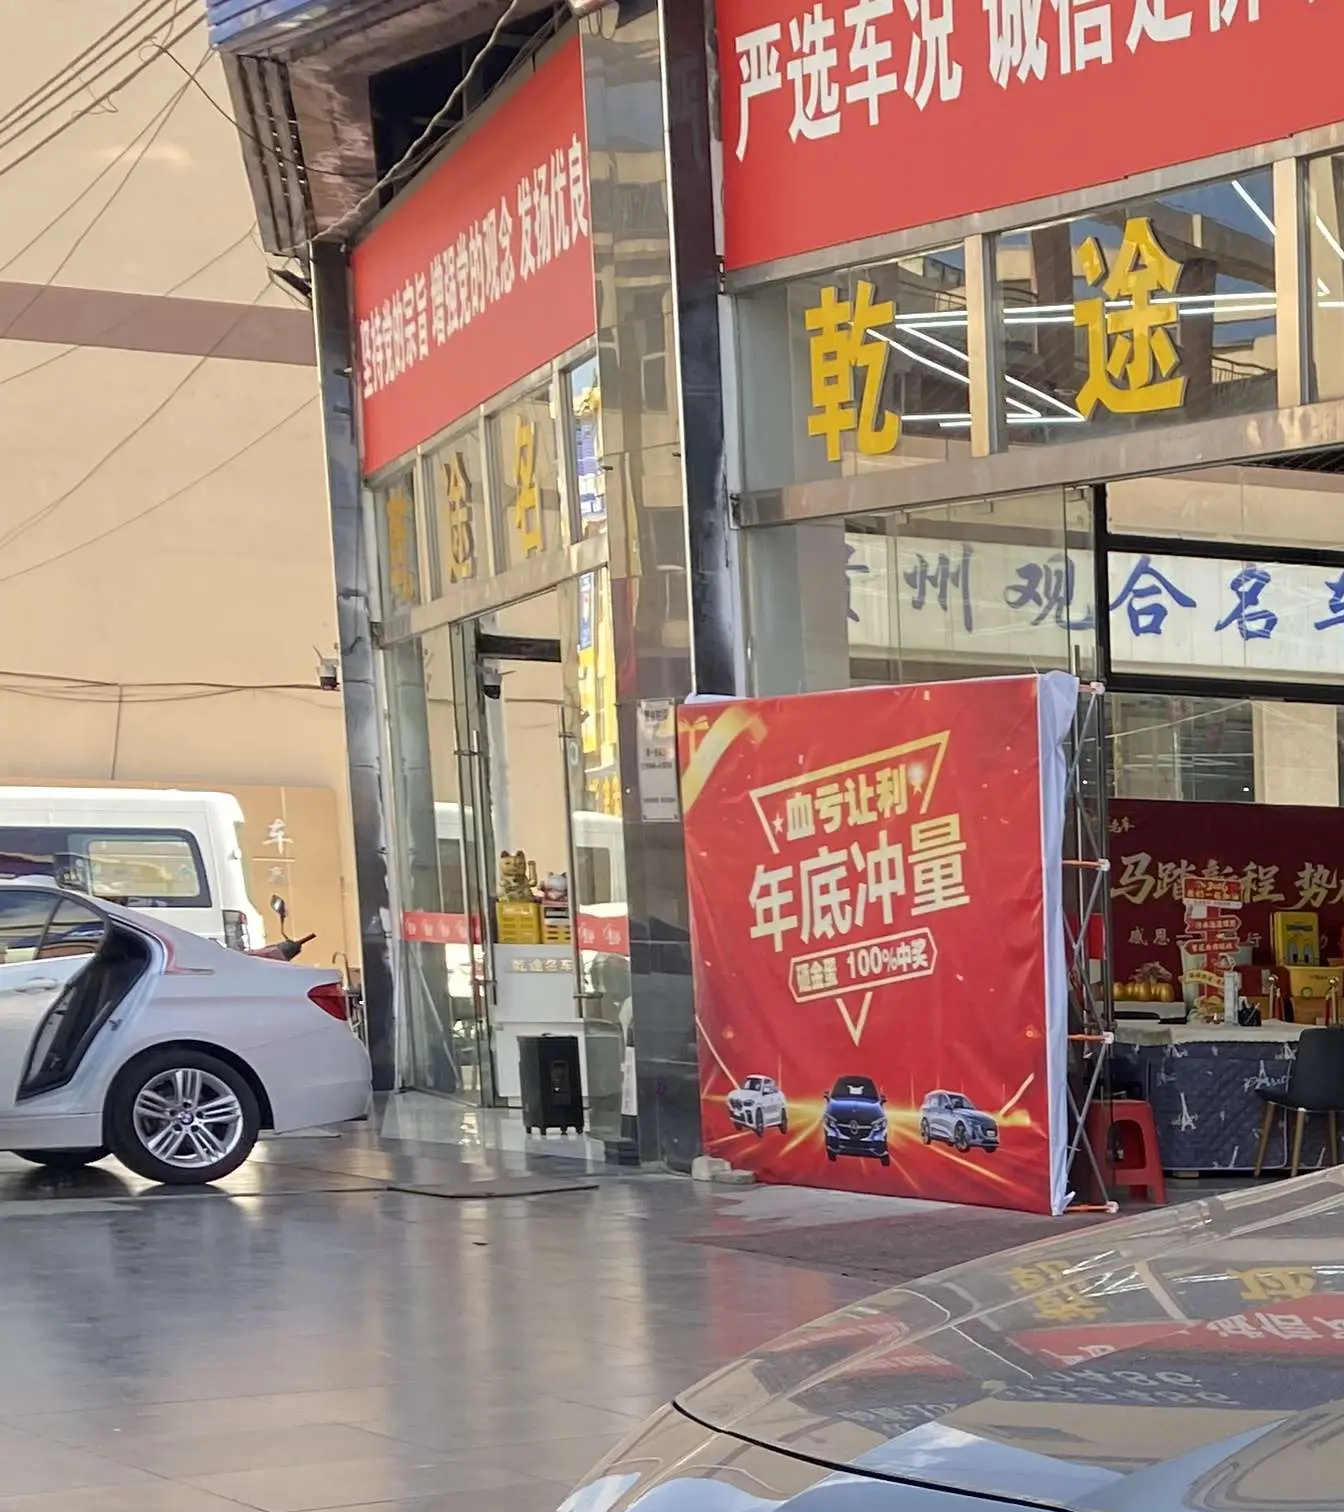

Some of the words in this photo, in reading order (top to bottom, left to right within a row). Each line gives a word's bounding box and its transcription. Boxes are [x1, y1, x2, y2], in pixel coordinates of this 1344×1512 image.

[735, 0, 963, 162] 严选车况
[360, 271, 429, 399] 坚持党的宗旨
[430, 196, 515, 346] 增强党的观念
[517, 133, 588, 282] 发扬优良
[786, 765, 908, 841] 血亏让利
[749, 813, 970, 953] 年底冲量
